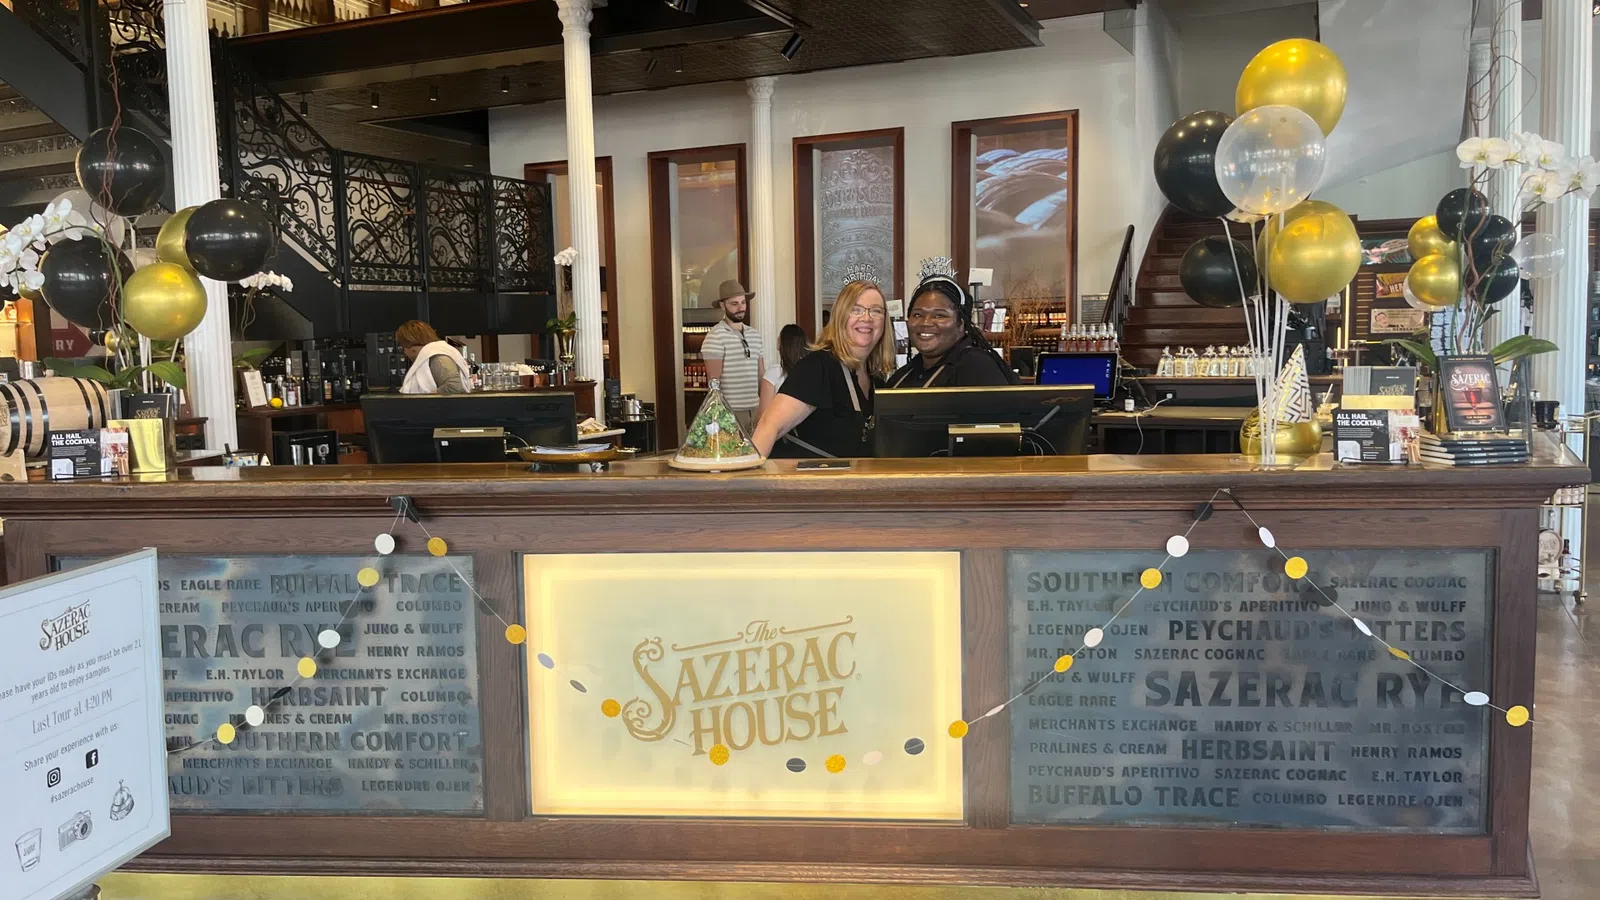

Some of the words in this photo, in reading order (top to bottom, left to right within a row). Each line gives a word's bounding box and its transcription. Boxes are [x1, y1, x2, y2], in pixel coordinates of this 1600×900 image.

[847, 263, 878, 274] HAPPY
[919, 256, 952, 268] HAPPY
[842, 272, 882, 286] BIRTHDAY
[1450, 373, 1491, 388] SAZERAC
[64, 438, 96, 446] COCKTAIL
[181, 580, 221, 590] EAGLE
[227, 579, 260, 590] RARE
[270, 573, 371, 594] BUFFAL
[384, 573, 462, 593] TRACE
[1027, 572, 1172, 592] SOUTHEN
[1330, 576, 1398, 588] SAZERAC
[1404, 576, 1466, 588] COGNAC
[222, 602, 300, 612] PEYCHAUD'S
[396, 601, 462, 612] COLUMBO
[1027, 600, 1054, 612] E.H.
[1239, 600, 1320, 612] APERITIVO
[1352, 600, 1392, 612] JUNG
[1398, 601, 1408, 612] &
[1416, 600, 1466, 612] WULFF
[39, 603, 92, 651] SAZERAC
[54, 619, 90, 651] HOUSE
[364, 624, 399, 634] JUNG
[404, 624, 414, 634] &
[419, 624, 463, 634] WULFF
[744, 620, 778, 643] The
[1110, 624, 1148, 636] OJEN
[1168, 620, 1334, 641] PEYCHAUD'S
[279, 624, 356, 658] RYE
[368, 646, 408, 657] HENRY
[417, 646, 464, 657] RAMOS
[1026, 648, 1052, 660] MR.
[1134, 648, 1200, 660] SAZERAC
[1204, 648, 1264, 660] COGNAC
[14, 682, 31, 694] have
[32, 676, 46, 691] your
[47, 671, 58, 684] IDs
[58, 663, 76, 679] ready
[76, 662, 85, 671] as
[85, 658, 96, 669] you
[97, 651, 112, 663] must
[113, 646, 121, 657] be
[121, 643, 134, 654] over
[134, 638, 142, 649] 21
[206, 670, 230, 680] E.H.
[233, 670, 284, 680] TAYLOR
[313, 668, 392, 680] MERCHANTS
[398, 668, 466, 680] EXCHANGE
[30, 689, 48, 704] years
[50, 682, 60, 696] old
[60, 680, 68, 690] to
[68, 674, 85, 689] enjoy
[85, 664, 110, 682] samples
[622, 632, 857, 742] SAZERAC
[1028, 672, 1065, 683] JUNG
[1071, 672, 1082, 684] &
[1088, 672, 1136, 684] WULFF
[1145, 670, 1358, 708] SAZERAC
[1376, 672, 1463, 708] RYE
[166, 692, 234, 702] APERITIVO
[252, 686, 387, 706] HERBSAINT
[400, 692, 467, 702] COLUMBO
[1028, 695, 1072, 706] EAGLE
[1079, 696, 1116, 707] RARE
[32, 714, 50, 734] Last
[52, 708, 72, 725] Tour
[74, 701, 82, 715] at
[84, 696, 100, 712] 4:20
[101, 688, 113, 705] PM
[229, 714, 290, 724] PRINES
[294, 714, 304, 724] &
[310, 714, 352, 724] CREAM
[384, 714, 408, 724] MR.
[412, 714, 468, 724] BOSTON
[690, 686, 848, 756] HOUSE
[1029, 718, 1116, 730] MERCHANTS
[1122, 720, 1197, 732] EXCHANGE
[1214, 720, 1262, 732] HANDY
[1267, 721, 1278, 732] &
[1284, 721, 1352, 732] SCHILLER
[1370, 722, 1397, 734] MR.
[1402, 723, 1465, 734] BOSTON
[24, 756, 44, 772] Share
[44, 750, 60, 765] your
[60, 733, 94, 756] experience
[94, 726, 108, 738] with
[109, 723, 120, 734] us:
[350, 732, 469, 751] COMFORT
[1030, 742, 1097, 754] PRALINES
[1103, 743, 1114, 754] &
[1119, 743, 1167, 754] CREAM
[1182, 739, 1334, 762] HERBSAINT
[1351, 746, 1400, 758] HENRY
[1408, 747, 1462, 758] RAMOS
[183, 758, 260, 769] MERCHANTS
[266, 758, 332, 769] EXCHANGE
[348, 758, 390, 769] HANDY
[394, 758, 404, 769] &
[409, 758, 468, 769] SCHILLER
[1028, 766, 1114, 778] PEYCHAUD'S
[1122, 766, 1200, 778] APERITIVO
[1214, 768, 1280, 780] SAZERAC
[1286, 769, 1347, 782] COGNAC
[1372, 771, 1400, 782] E.H.
[1404, 772, 1463, 783] TAYLOR
[50, 776, 94, 804] #sazerachouse
[242, 776, 342, 796] BITTERS
[362, 780, 430, 792] LEGENDRE
[436, 780, 470, 792] OJEN
[1028, 784, 1142, 806] BUFFALO
[1154, 786, 1240, 808] TRACE
[1252, 792, 1328, 805] COLUMBO
[1338, 794, 1417, 806] LEGENDRE
[1425, 795, 1462, 807] OJEN
